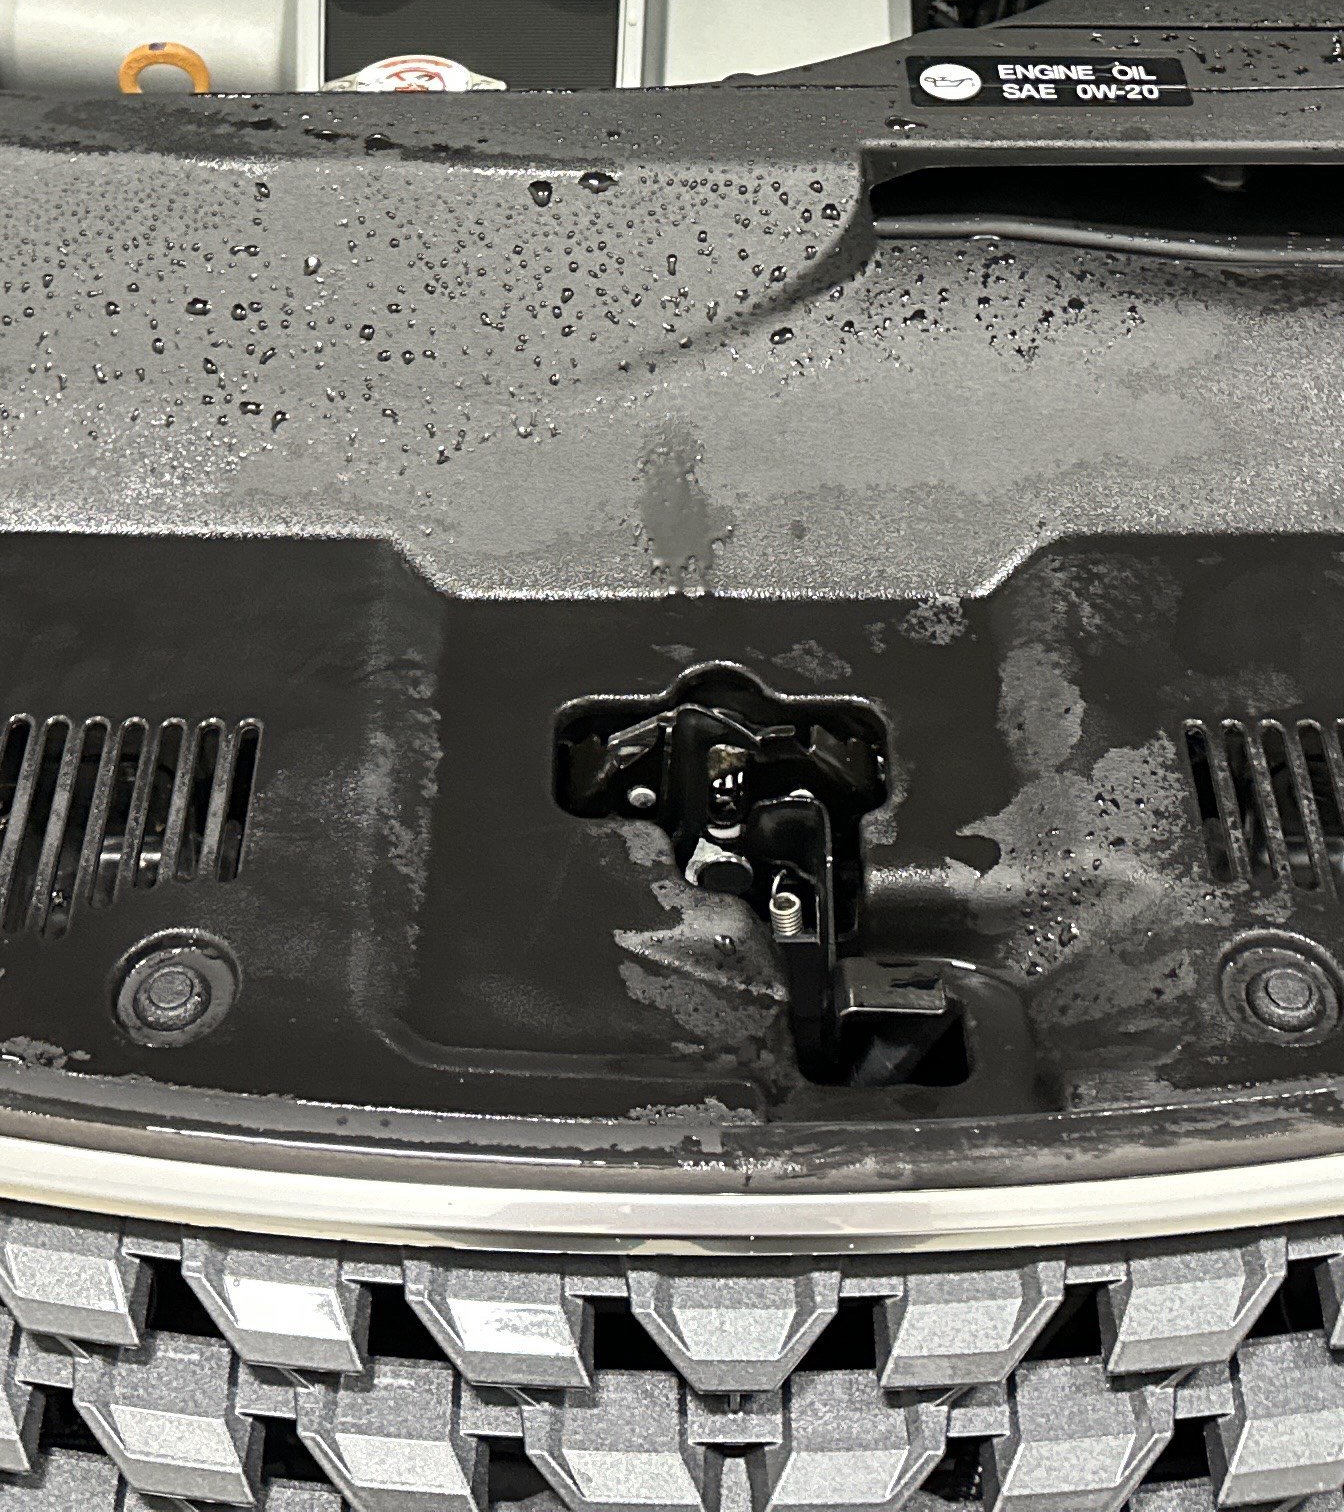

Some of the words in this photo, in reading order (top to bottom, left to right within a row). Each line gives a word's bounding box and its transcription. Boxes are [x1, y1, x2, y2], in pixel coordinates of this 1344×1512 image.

[997, 64, 1096, 80] ENGINE
[1112, 64, 1157, 80] OIL
[1002, 83, 1058, 100] SAE
[1076, 83, 1160, 101] 0W-20
